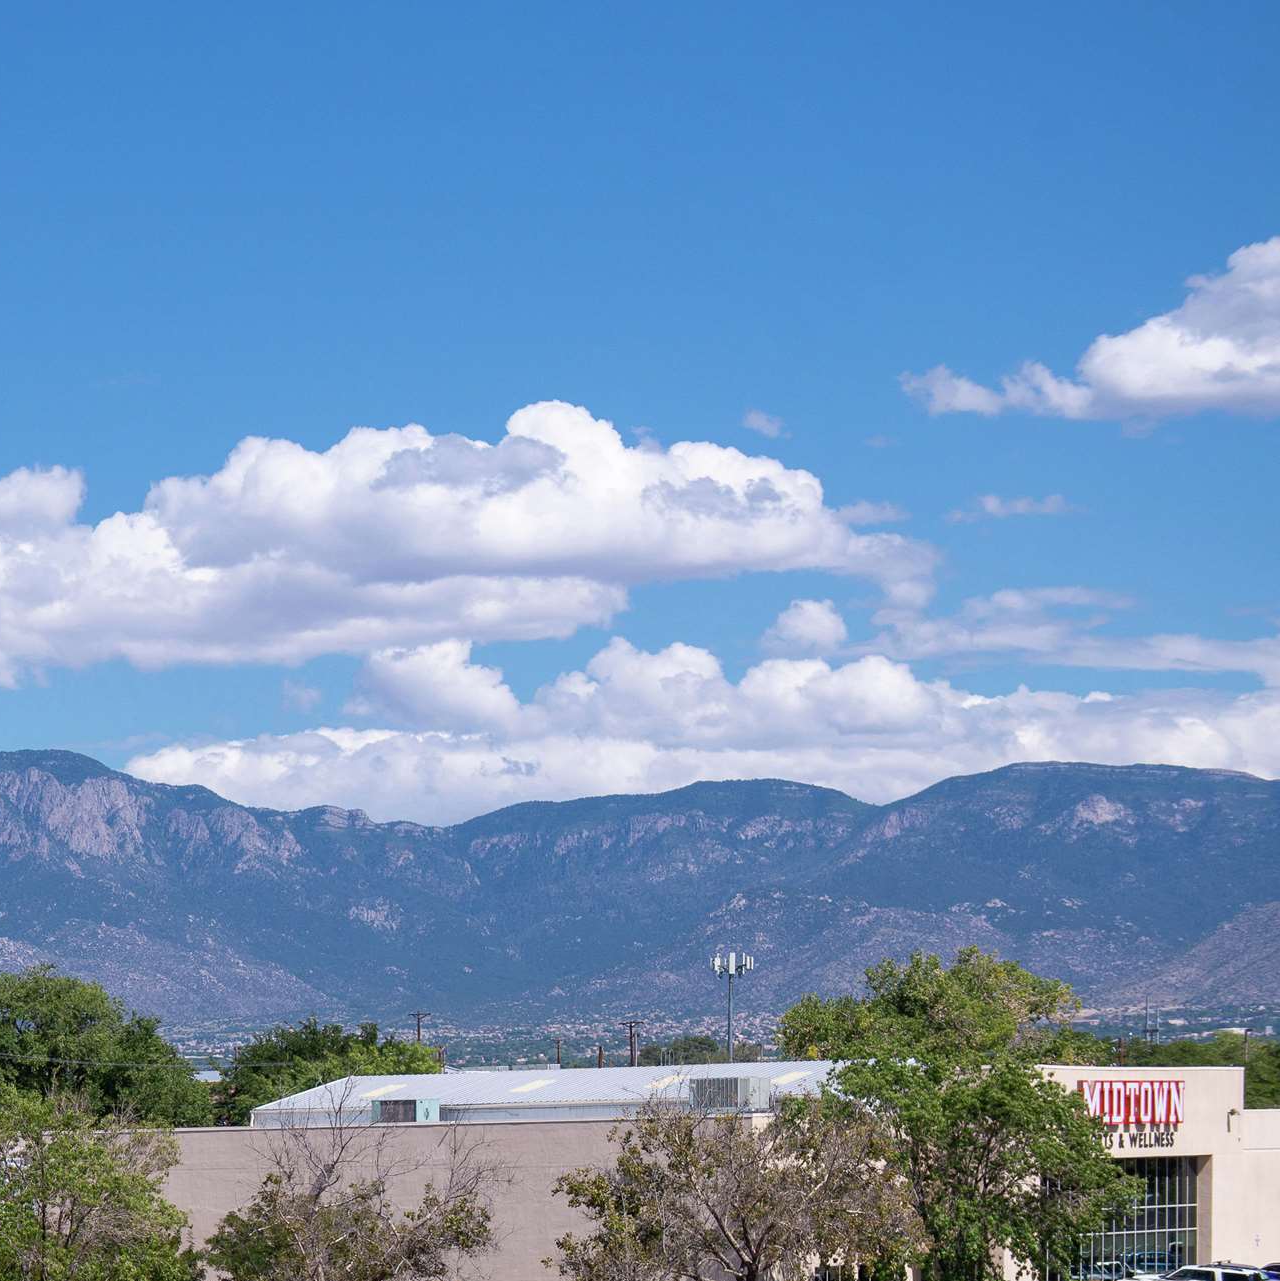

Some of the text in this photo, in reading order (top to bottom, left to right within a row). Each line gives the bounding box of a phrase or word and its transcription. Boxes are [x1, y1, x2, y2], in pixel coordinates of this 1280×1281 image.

[1082, 1080, 1185, 1124] MIDTOWN
[1118, 1133, 1124, 1148] &
[1128, 1132, 1174, 1148] WELLNESS
